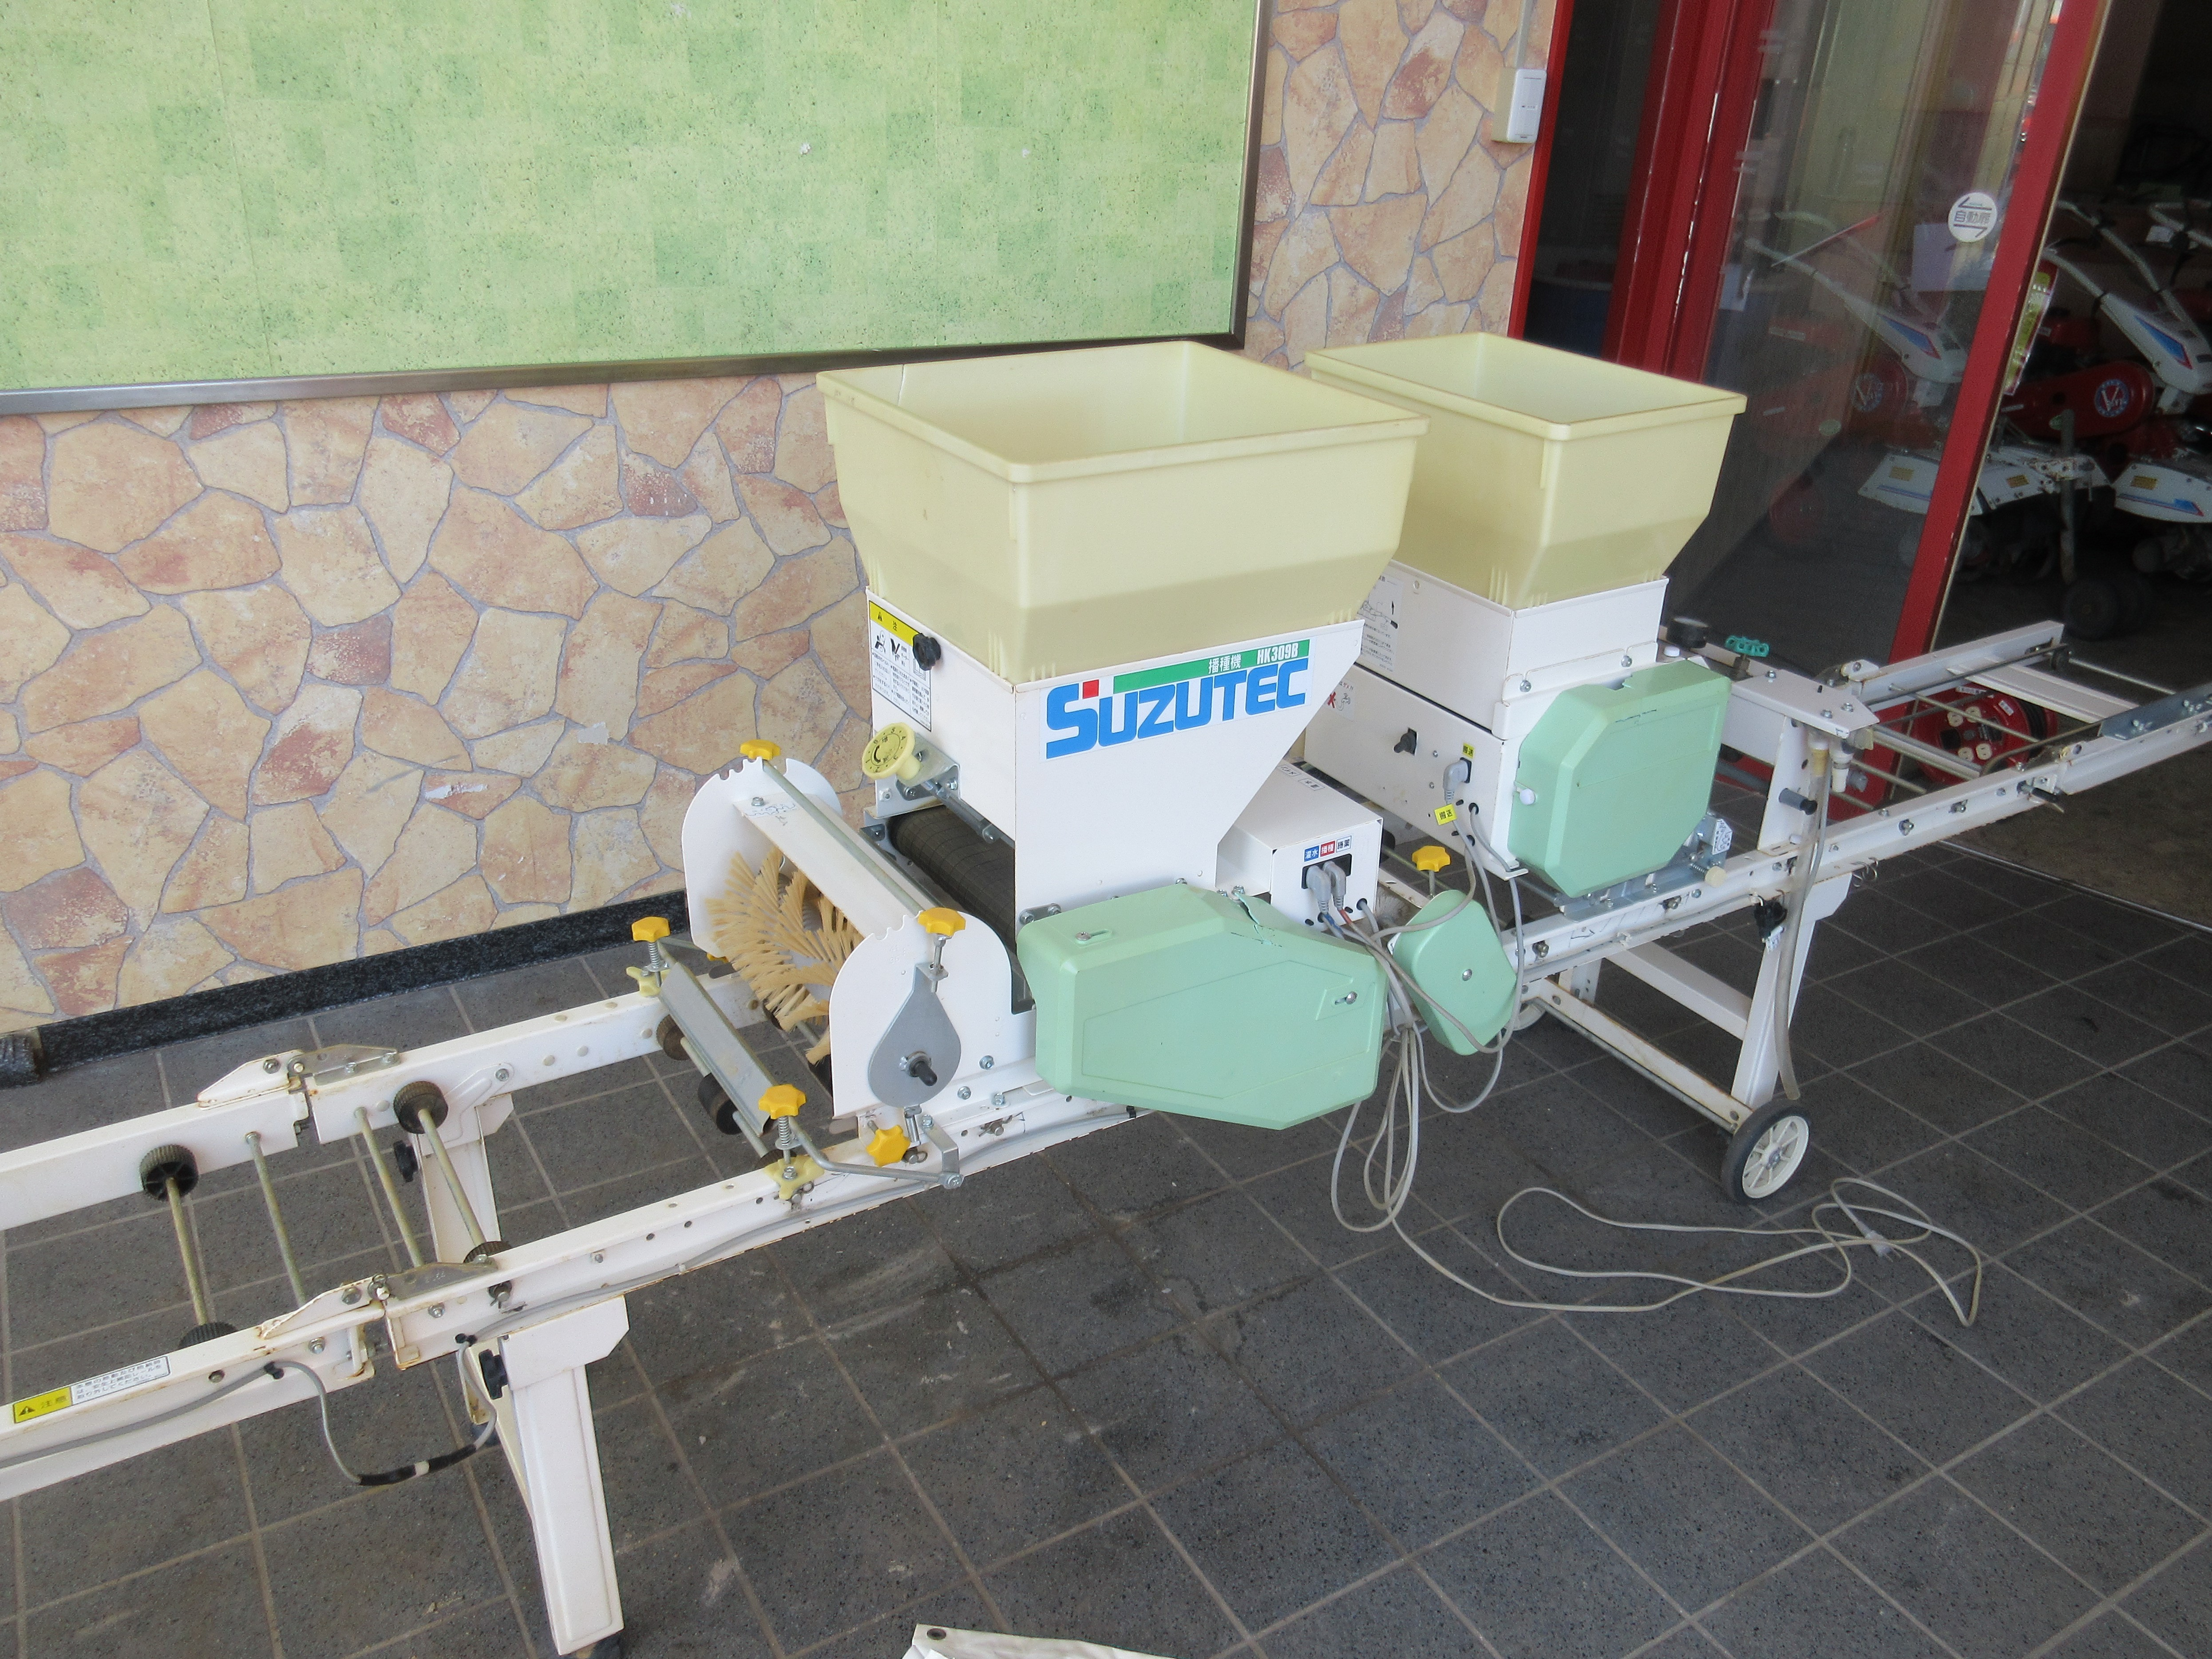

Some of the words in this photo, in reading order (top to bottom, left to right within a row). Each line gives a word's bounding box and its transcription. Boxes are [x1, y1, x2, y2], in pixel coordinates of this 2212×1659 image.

[1208, 653, 1242, 674] 播種機
[1257, 643, 1299, 665] HK309B
[1046, 657, 1309, 760] SUZUTEC
[1305, 849, 1318, 859] 灌水
[1321, 843, 1334, 855] 播種
[40, 1395, 67, 1410] 注意
